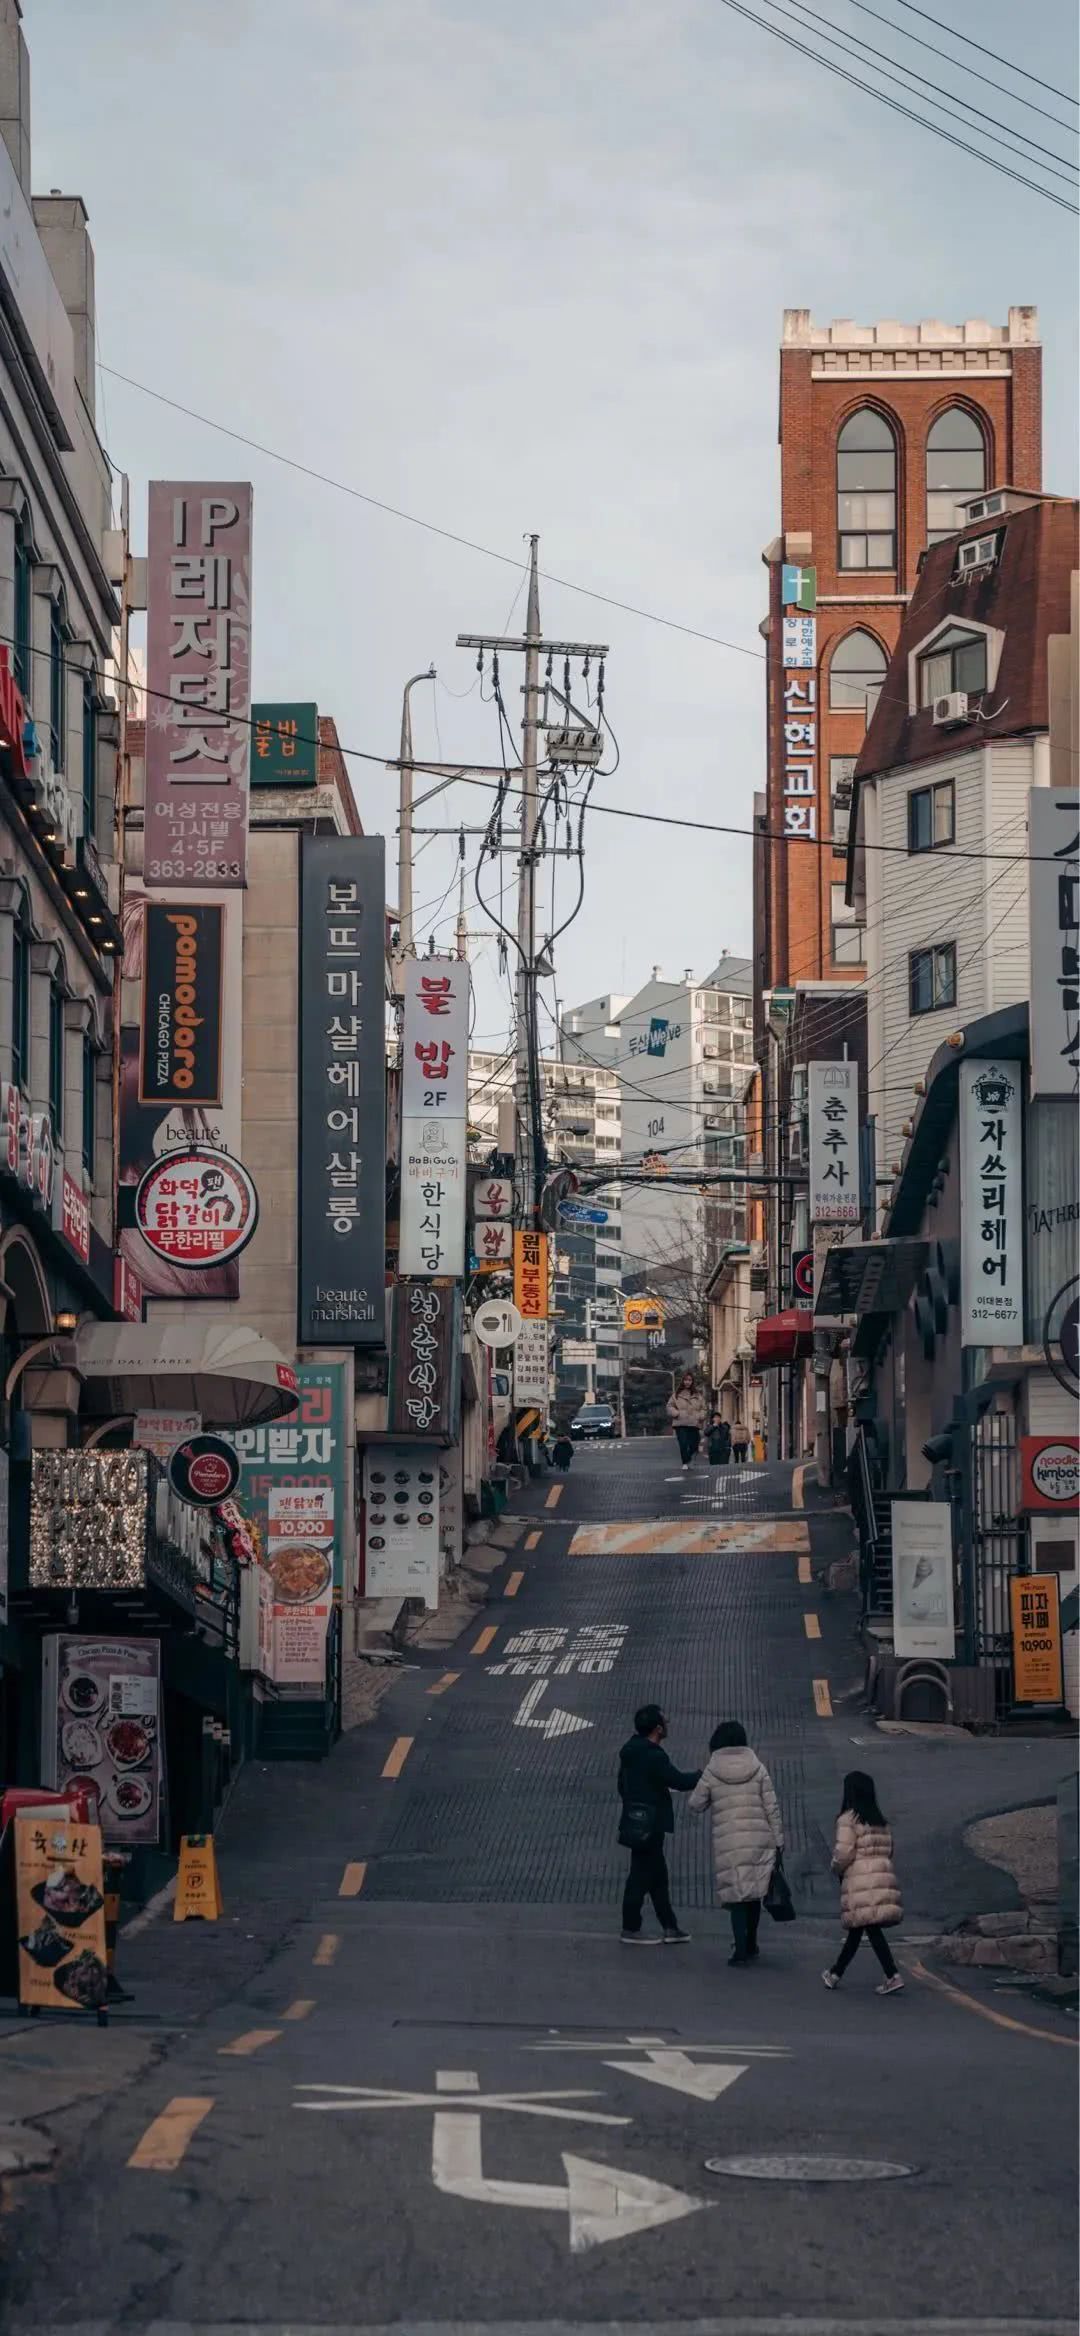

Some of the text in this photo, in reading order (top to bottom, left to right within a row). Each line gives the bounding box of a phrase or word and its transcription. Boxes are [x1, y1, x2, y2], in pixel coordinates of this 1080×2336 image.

[172, 497, 239, 548] IP
[168, 554, 232, 787] 레지던스
[783, 679, 816, 840] 신현교회
[155, 802, 242, 820] 여성전용
[167, 819, 230, 838] 고시텔
[149, 859, 241, 879] 363-2833
[166, 913, 205, 1090] pomodoro
[414, 976, 457, 1081] 불밥
[156, 992, 170, 1086] CHICAGO PIZZA
[423, 1091, 447, 1107] 2F
[167, 1123, 221, 1141] beauté
[647, 1117, 665, 1137] 104
[821, 1097, 849, 1188] 춘추사
[158, 1178, 201, 1197] 화덕
[815, 1205, 858, 1218] 312-6661
[979, 1119, 1007, 1287] 자쓰리헤어
[155, 1202, 221, 1228] 닭갈비
[1029, 1201, 1079, 1234] JATHR
[419, 1181, 445, 1272] 한식당
[157, 1231, 227, 1251] 무한리필
[315, 1288, 368, 1303] beauté
[977, 1296, 1013, 1307] 이대본점
[311, 1304, 376, 1322] marshall
[971, 1309, 1018, 1320] 312-6677
[279, 1521, 326, 1537] 10,900
[1020, 1593, 1049, 1611] 피자
[1020, 1639, 1053, 1653] 10,900
